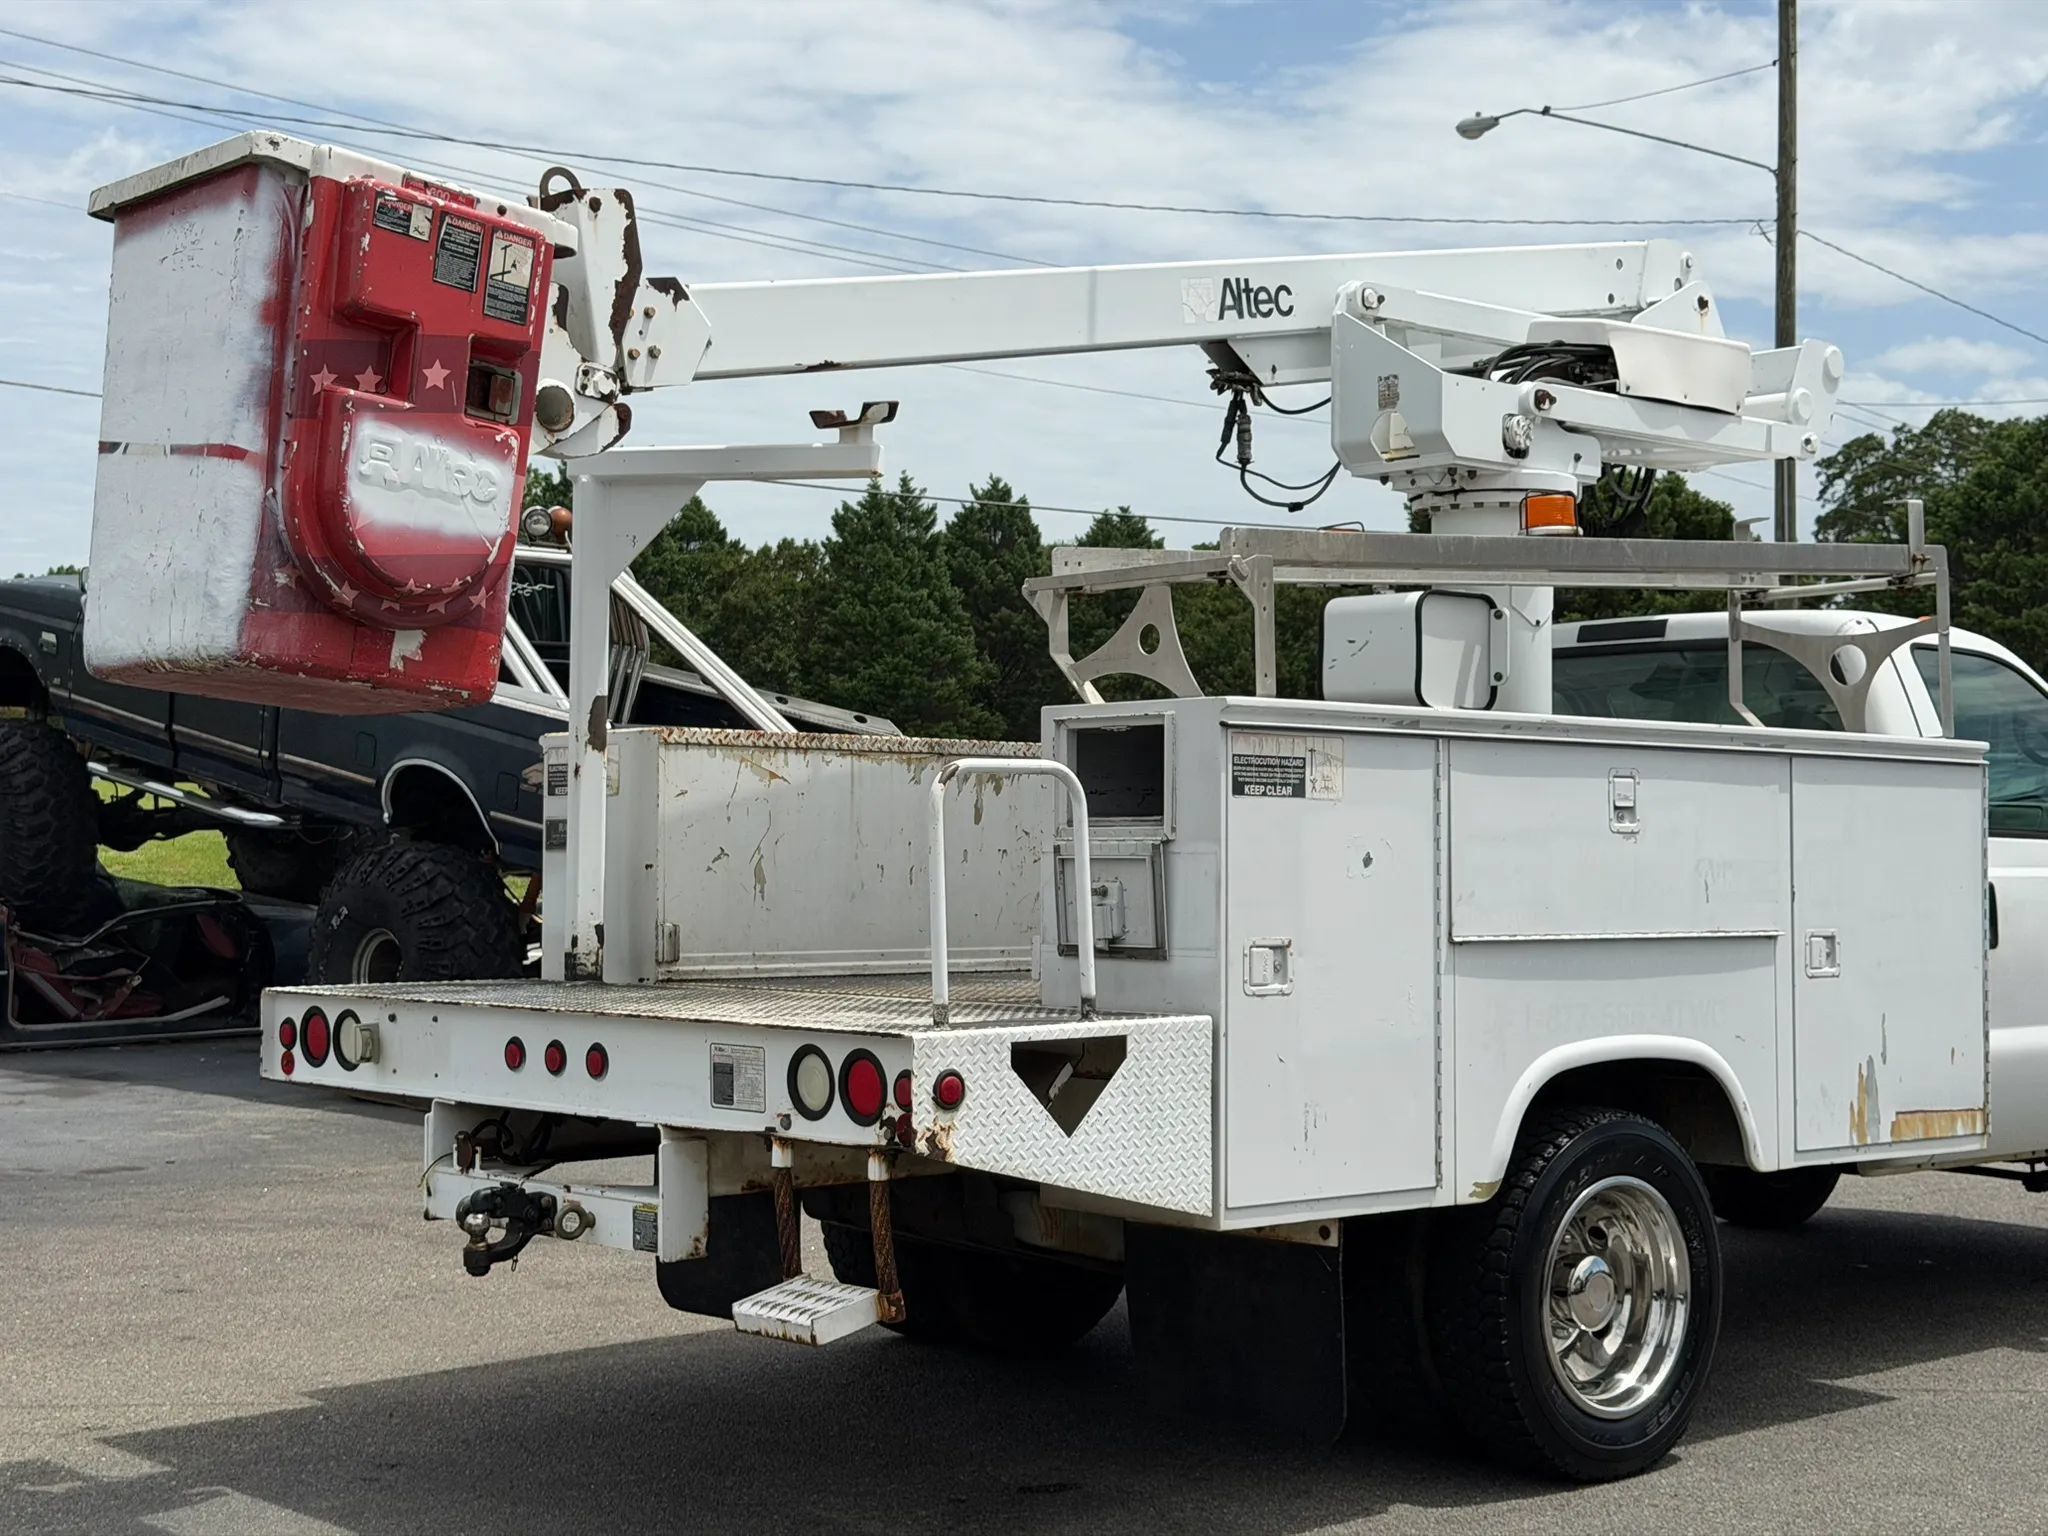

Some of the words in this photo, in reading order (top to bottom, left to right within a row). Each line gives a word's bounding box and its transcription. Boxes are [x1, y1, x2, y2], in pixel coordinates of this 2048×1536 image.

[452, 217, 482, 232] DANGER
[503, 232, 533, 247] DANGER
[1218, 277, 1294, 320] Altec
[1233, 756, 1280, 766] ELECTROCUTION
[1281, 758, 1304, 767] HAZARD
[1244, 784, 1265, 795] KEEP
[1266, 785, 1292, 796] CLEAR
